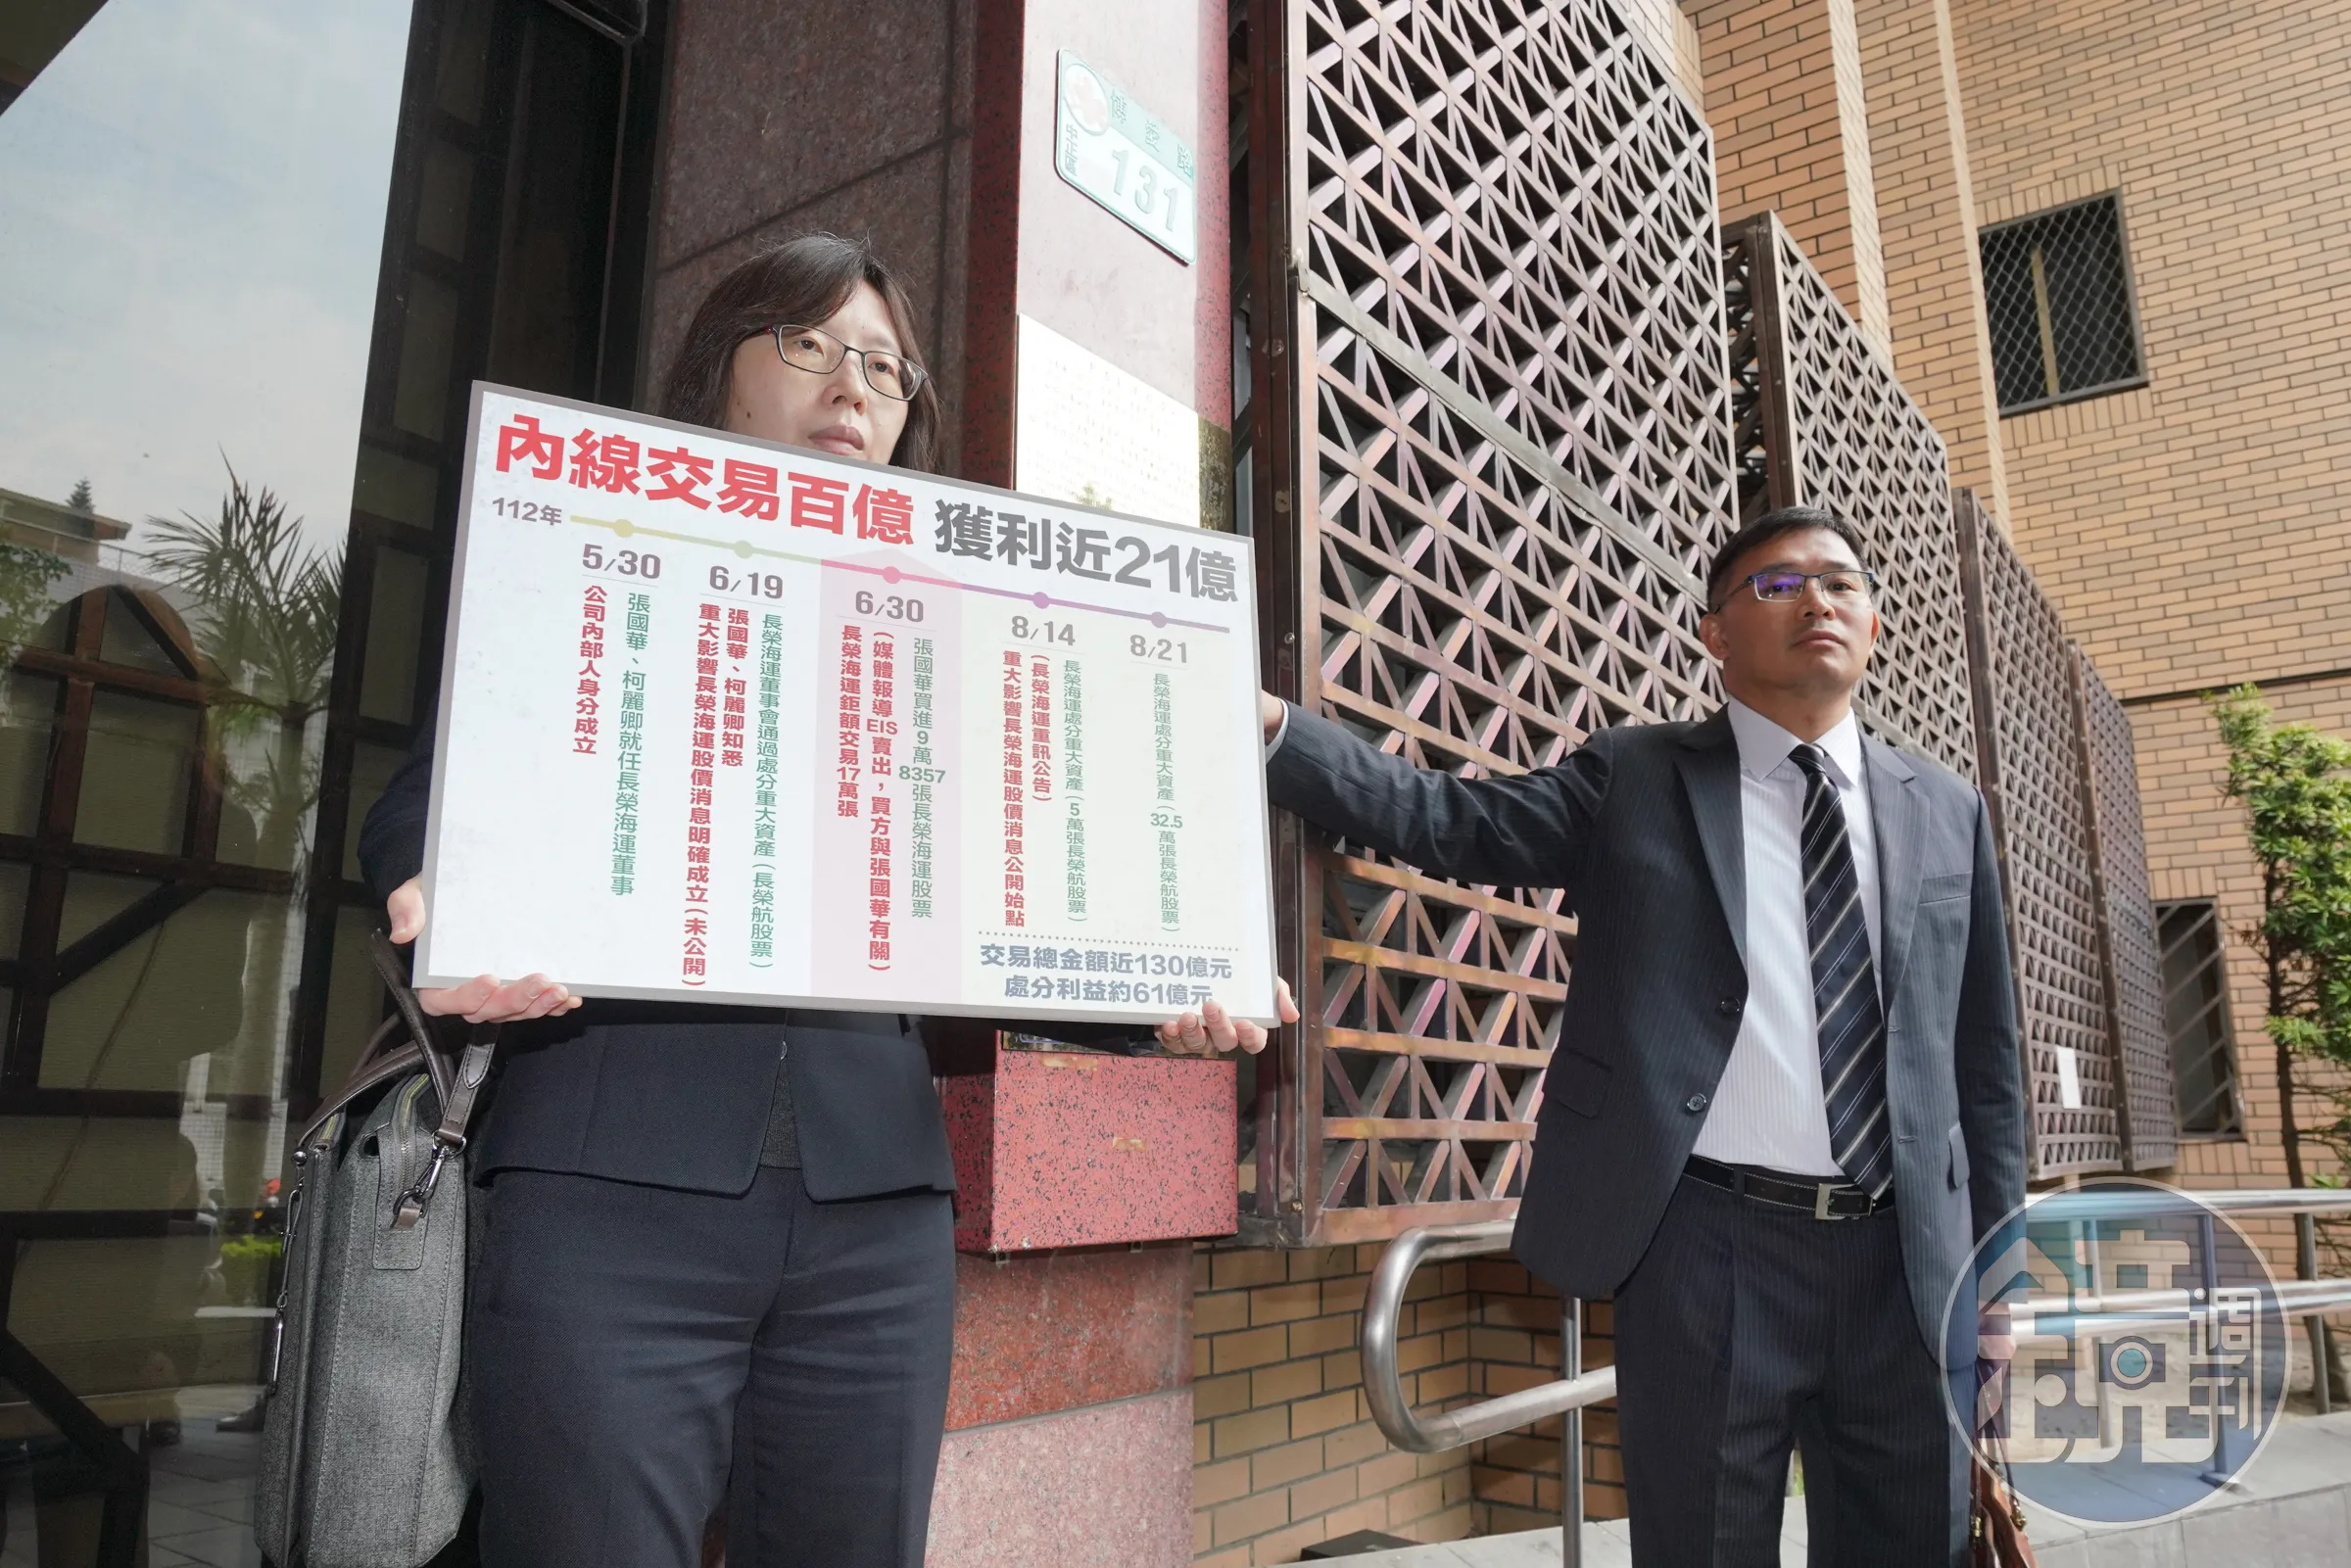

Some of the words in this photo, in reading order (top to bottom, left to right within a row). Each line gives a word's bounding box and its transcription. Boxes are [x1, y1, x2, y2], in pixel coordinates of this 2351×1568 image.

[1112, 149, 1177, 232] 131
[492, 497, 562, 526] 112年
[495, 413, 914, 546] 內線交易百億
[935, 499, 1238, 603] 獲利近21億
[582, 544, 661, 579] 5/30
[709, 565, 783, 598] 6/19
[855, 591, 924, 622] 6/30
[1011, 616, 1076, 645] 8/14
[1129, 635, 1187, 663] 8/21
[573, 586, 607, 755] 公司內部人身分成立
[721, 608, 749, 767] 張國華、柯麗卿知悉
[610, 593, 650, 895] 張國華、柯麗卿就任長榮海運董事
[1003, 650, 1025, 927] 重大影響長榮海運股價消息公開始點
[980, 943, 1232, 978] 交易總金額近130億元
[1004, 974, 1213, 1006] 處分利益約61億元
